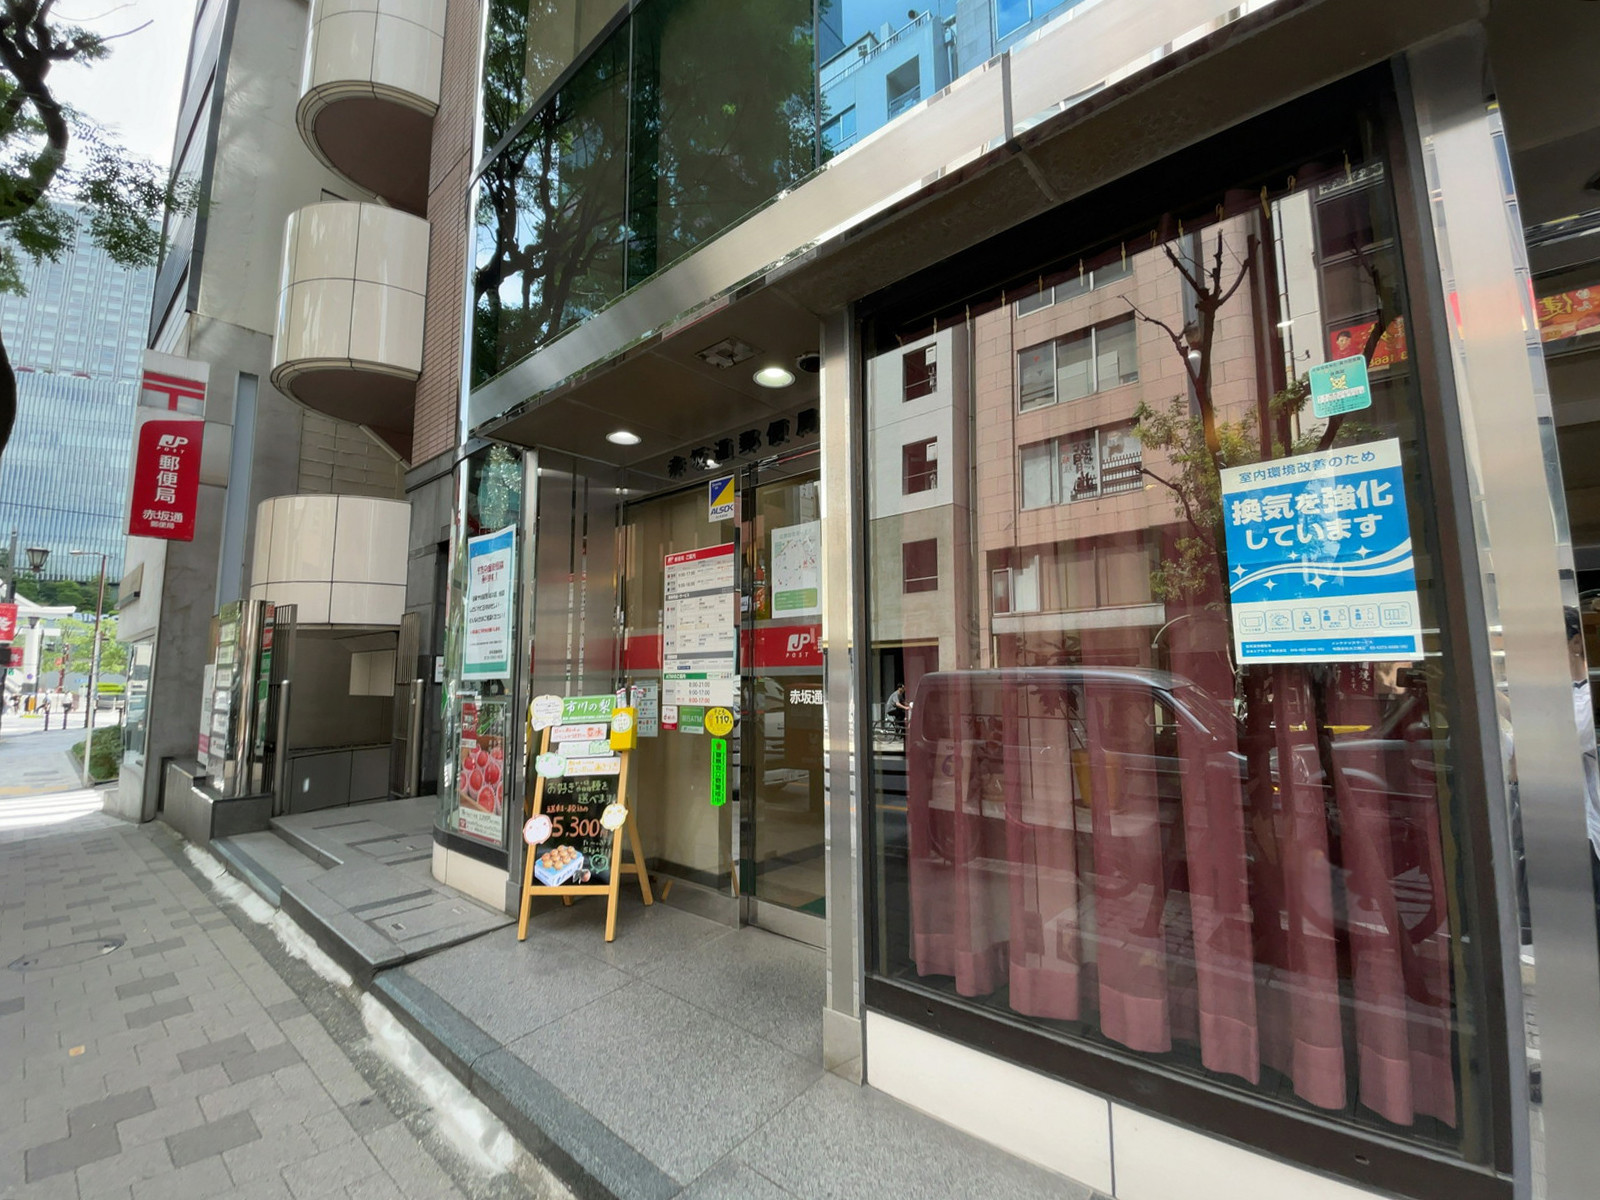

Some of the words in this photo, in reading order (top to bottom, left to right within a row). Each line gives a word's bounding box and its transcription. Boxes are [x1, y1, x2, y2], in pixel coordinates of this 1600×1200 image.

[154, 454, 180, 504] 郵便局
[1239, 450, 1376, 484] 室内環境改善のため
[1232, 479, 1394, 526] 換気を強化
[142, 509, 183, 523] 赤坂通
[1245, 513, 1384, 550] しています
[785, 650, 810, 659] POST
[565, 699, 611, 716] 市川の梨
[789, 689, 823, 706] 赤坂通
